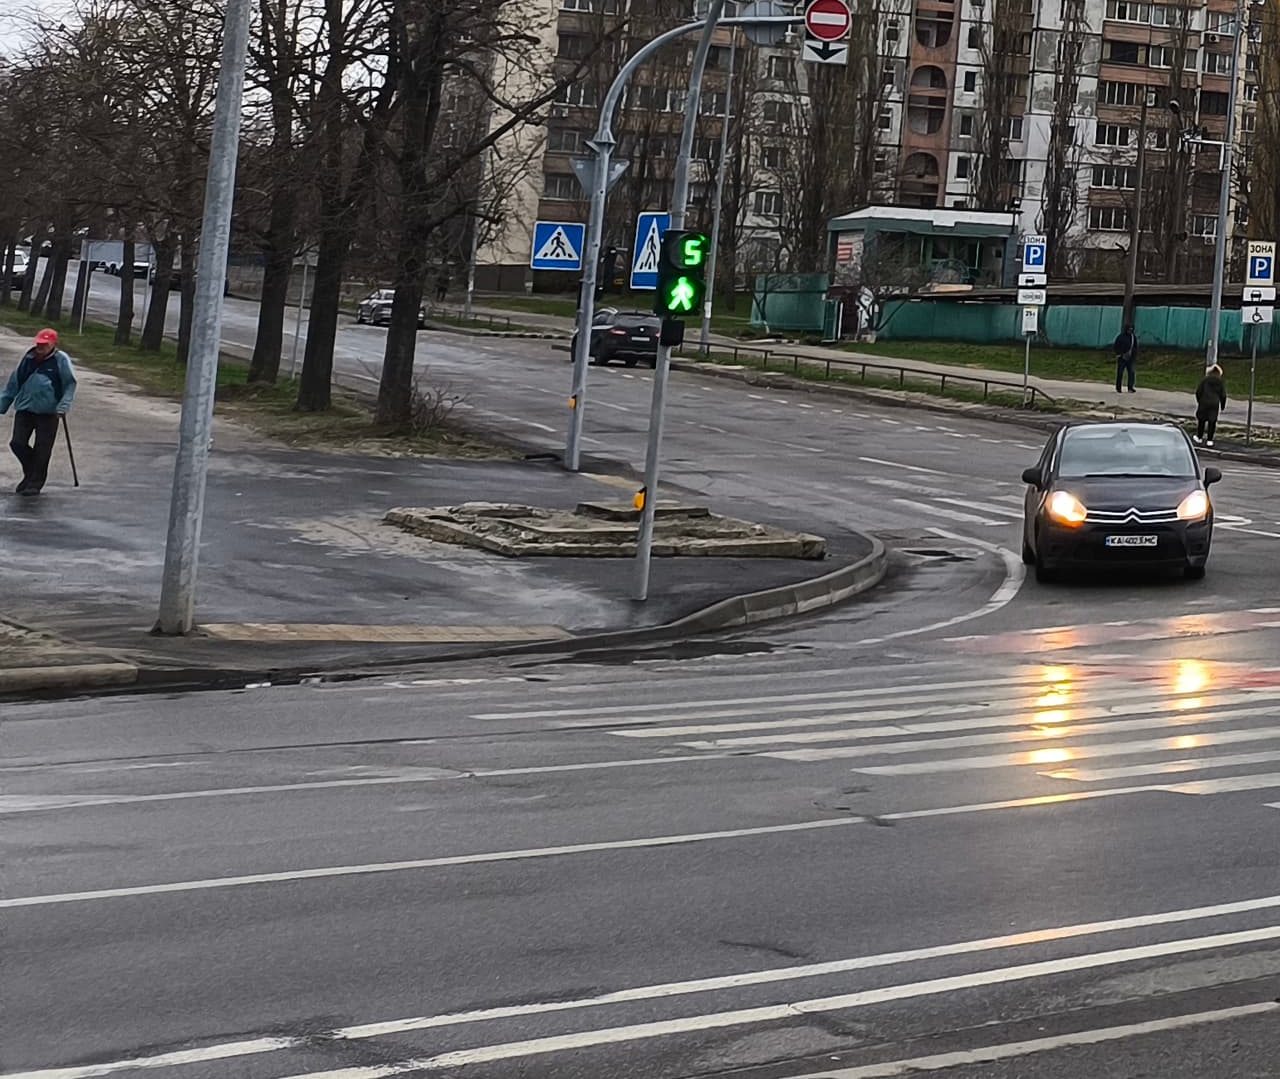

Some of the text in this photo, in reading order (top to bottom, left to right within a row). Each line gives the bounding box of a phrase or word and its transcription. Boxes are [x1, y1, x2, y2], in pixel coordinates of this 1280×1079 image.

[1030, 246, 1041, 265] P
[1250, 244, 1273, 254] ЗОНА
[1255, 258, 1268, 277] P
